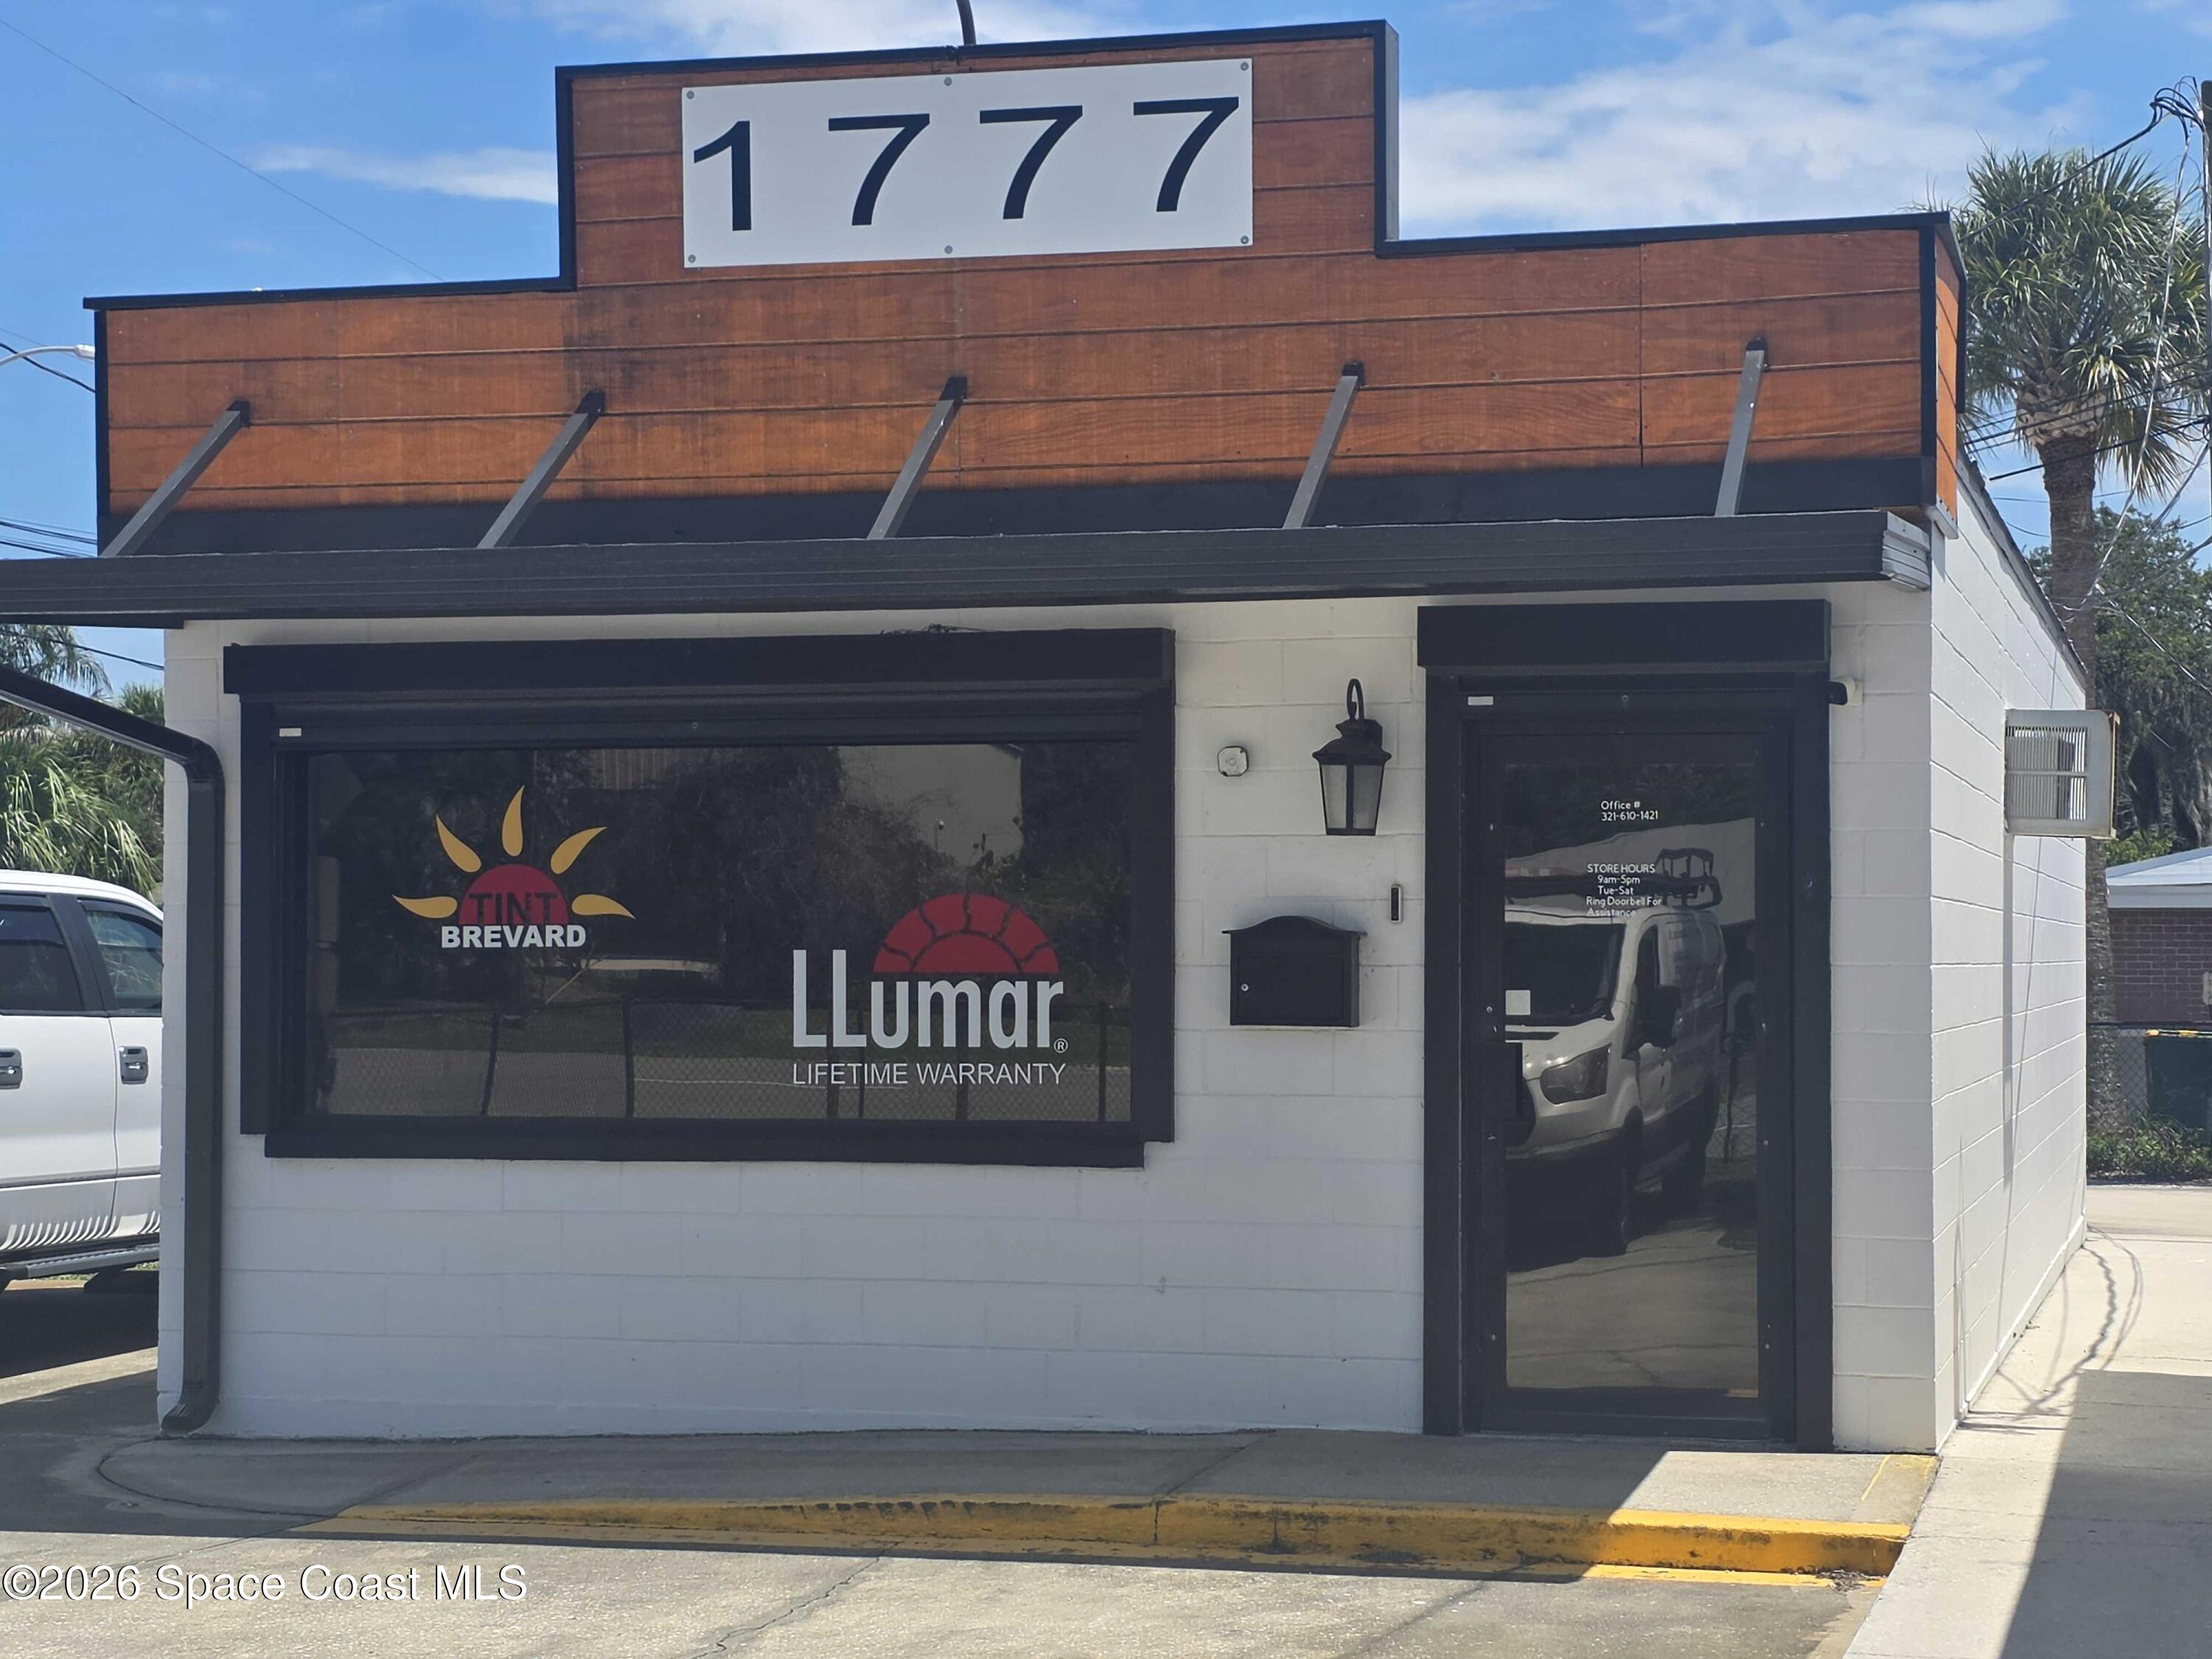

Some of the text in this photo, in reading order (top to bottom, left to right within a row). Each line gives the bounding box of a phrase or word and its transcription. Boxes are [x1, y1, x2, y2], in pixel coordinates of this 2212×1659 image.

[692, 96, 1239, 232] 1777
[1601, 801, 1631, 810] Office
[1601, 810, 1658, 821] 321-610-1421
[1587, 863, 1656, 873] STORE HOURS
[1597, 874, 1641, 886] 9am-5pm
[1598, 886, 1634, 895] Tue-Sat
[468, 892, 558, 924] TINT
[1586, 896, 1663, 908] Ring Doorbell For
[1587, 908, 1638, 917] Assistance
[441, 925, 586, 948] BREVARD
[793, 1062, 1066, 1085] LIFETIME WARRANTY
